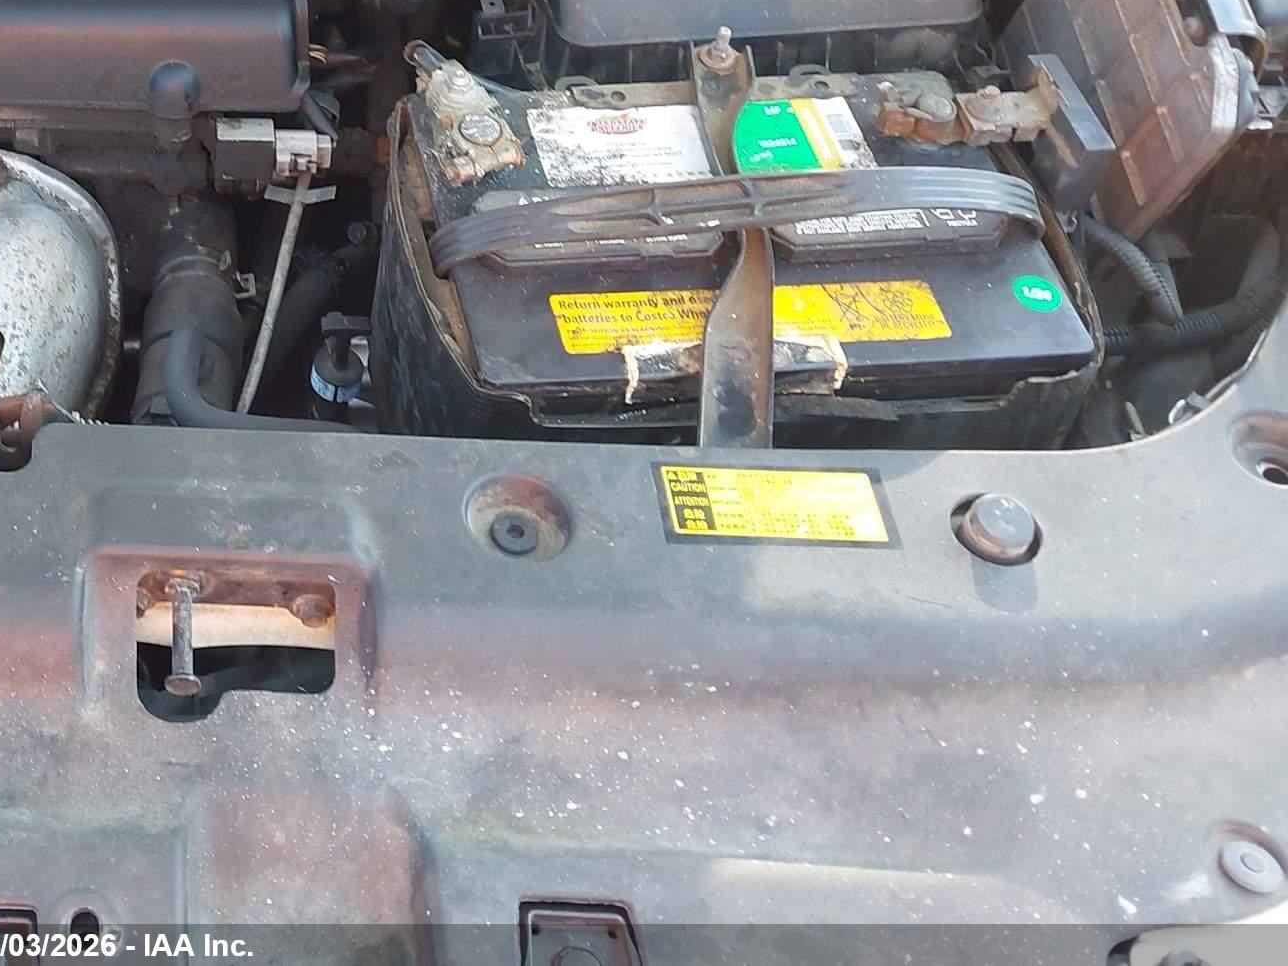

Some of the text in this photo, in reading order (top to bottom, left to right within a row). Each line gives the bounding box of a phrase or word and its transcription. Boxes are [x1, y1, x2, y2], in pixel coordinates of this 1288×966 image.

[558, 298, 601, 311] Return
[604, 295, 659, 309] warranty
[662, 293, 686, 306] and
[562, 311, 617, 324] batteries
[620, 311, 633, 323] to
[635, 309, 676, 323] Costco
[670, 481, 707, 493] CAUTION
[674, 495, 710, 507] ATTENTION
